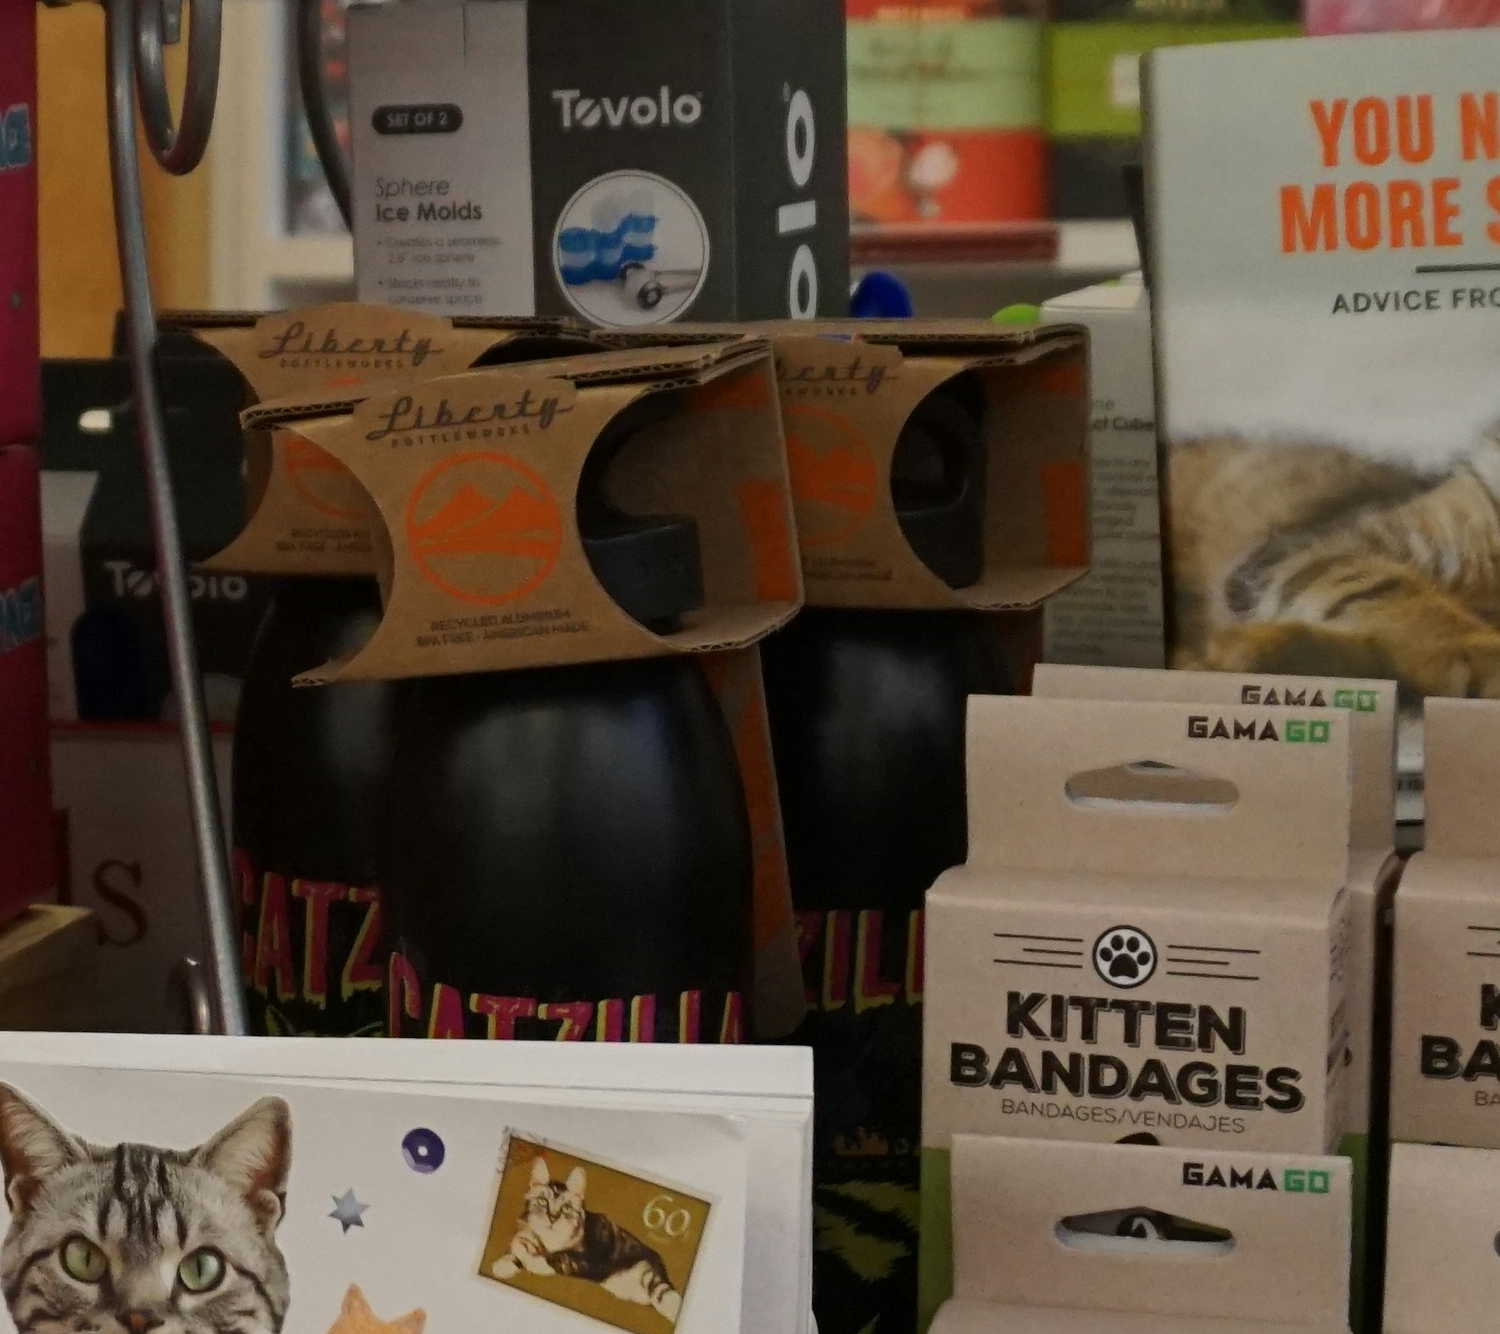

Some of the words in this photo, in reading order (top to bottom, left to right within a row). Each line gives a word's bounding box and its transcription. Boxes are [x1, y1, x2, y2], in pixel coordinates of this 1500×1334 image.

[414, 113, 434, 127] OF
[437, 112, 448, 127] 2
[553, 85, 702, 130] Tovolo
[1308, 93, 1436, 168] YOU
[375, 178, 450, 200] Sphere
[375, 203, 411, 223] Ice
[416, 201, 483, 222] Molds
[1279, 177, 1464, 256] MORE
[1332, 289, 1442, 315] ADVICE
[259, 322, 444, 365] Liberty
[1005, 989, 1247, 1056] KITTEN
[949, 1041, 1305, 1114] BANDAGES
[642, 1194, 691, 1237] 60
